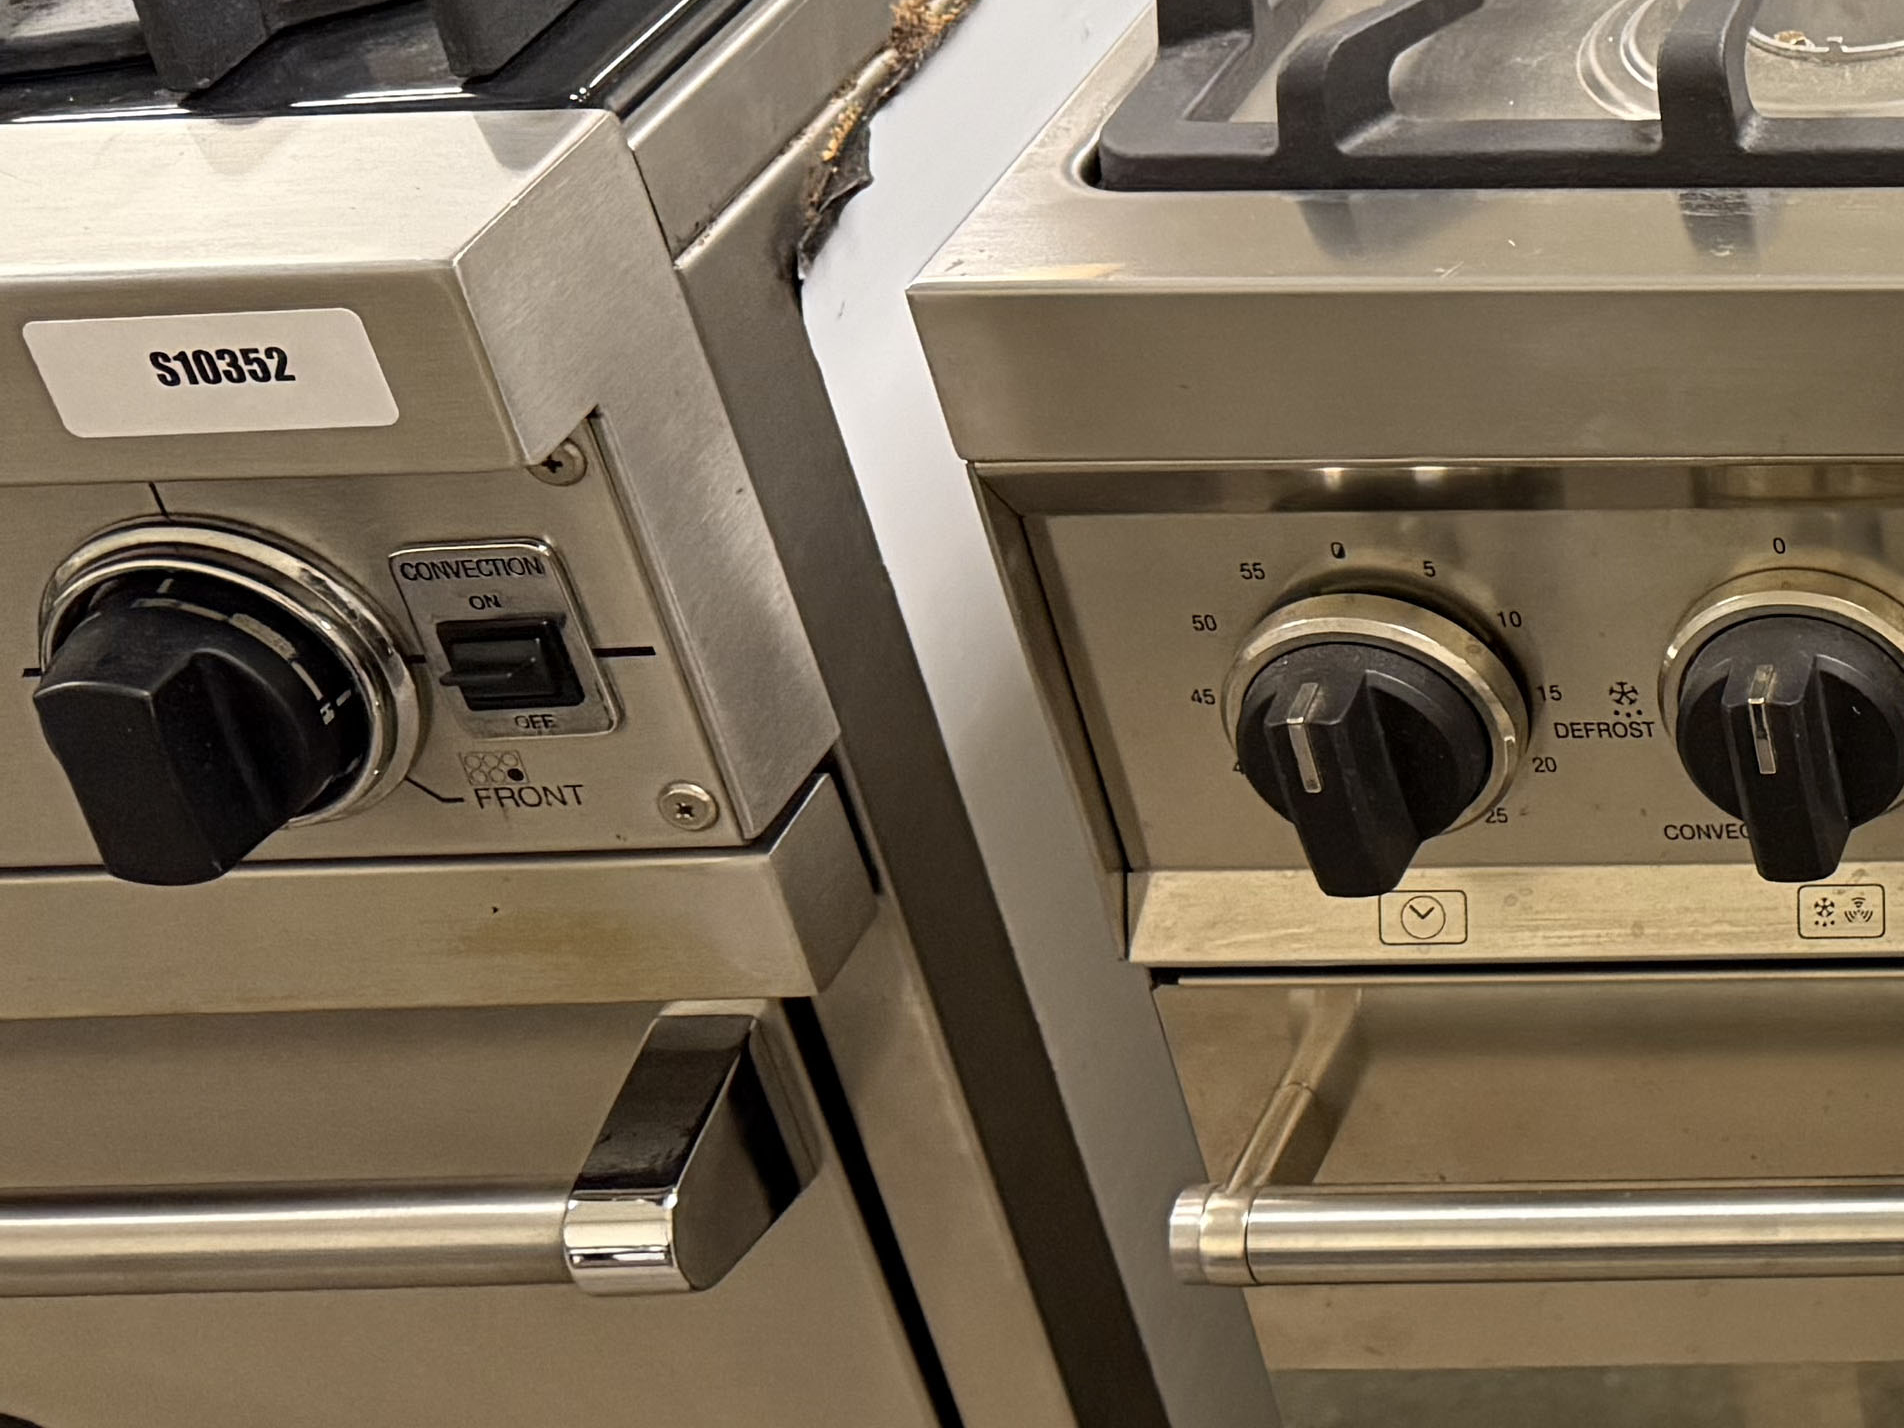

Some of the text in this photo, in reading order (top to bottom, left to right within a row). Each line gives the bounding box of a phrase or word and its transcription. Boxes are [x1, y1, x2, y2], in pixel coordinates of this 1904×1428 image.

[149, 346, 296, 387] S10352
[400, 557, 544, 581] CONVECTION
[1240, 563, 1265, 581] 55
[1423, 561, 1436, 577] 5
[468, 594, 501, 610] ON
[1192, 615, 1217, 631] 50
[1497, 611, 1521, 628] 10
[1191, 689, 1215, 705] 45
[1537, 685, 1562, 702] 15
[514, 713, 556, 729] OFF
[1555, 721, 1655, 739] DEFROST
[1532, 757, 1557, 773] 20
[474, 784, 584, 809] FRONT
[1486, 808, 1508, 824] 25
[1664, 823, 1750, 841] CONVEC
